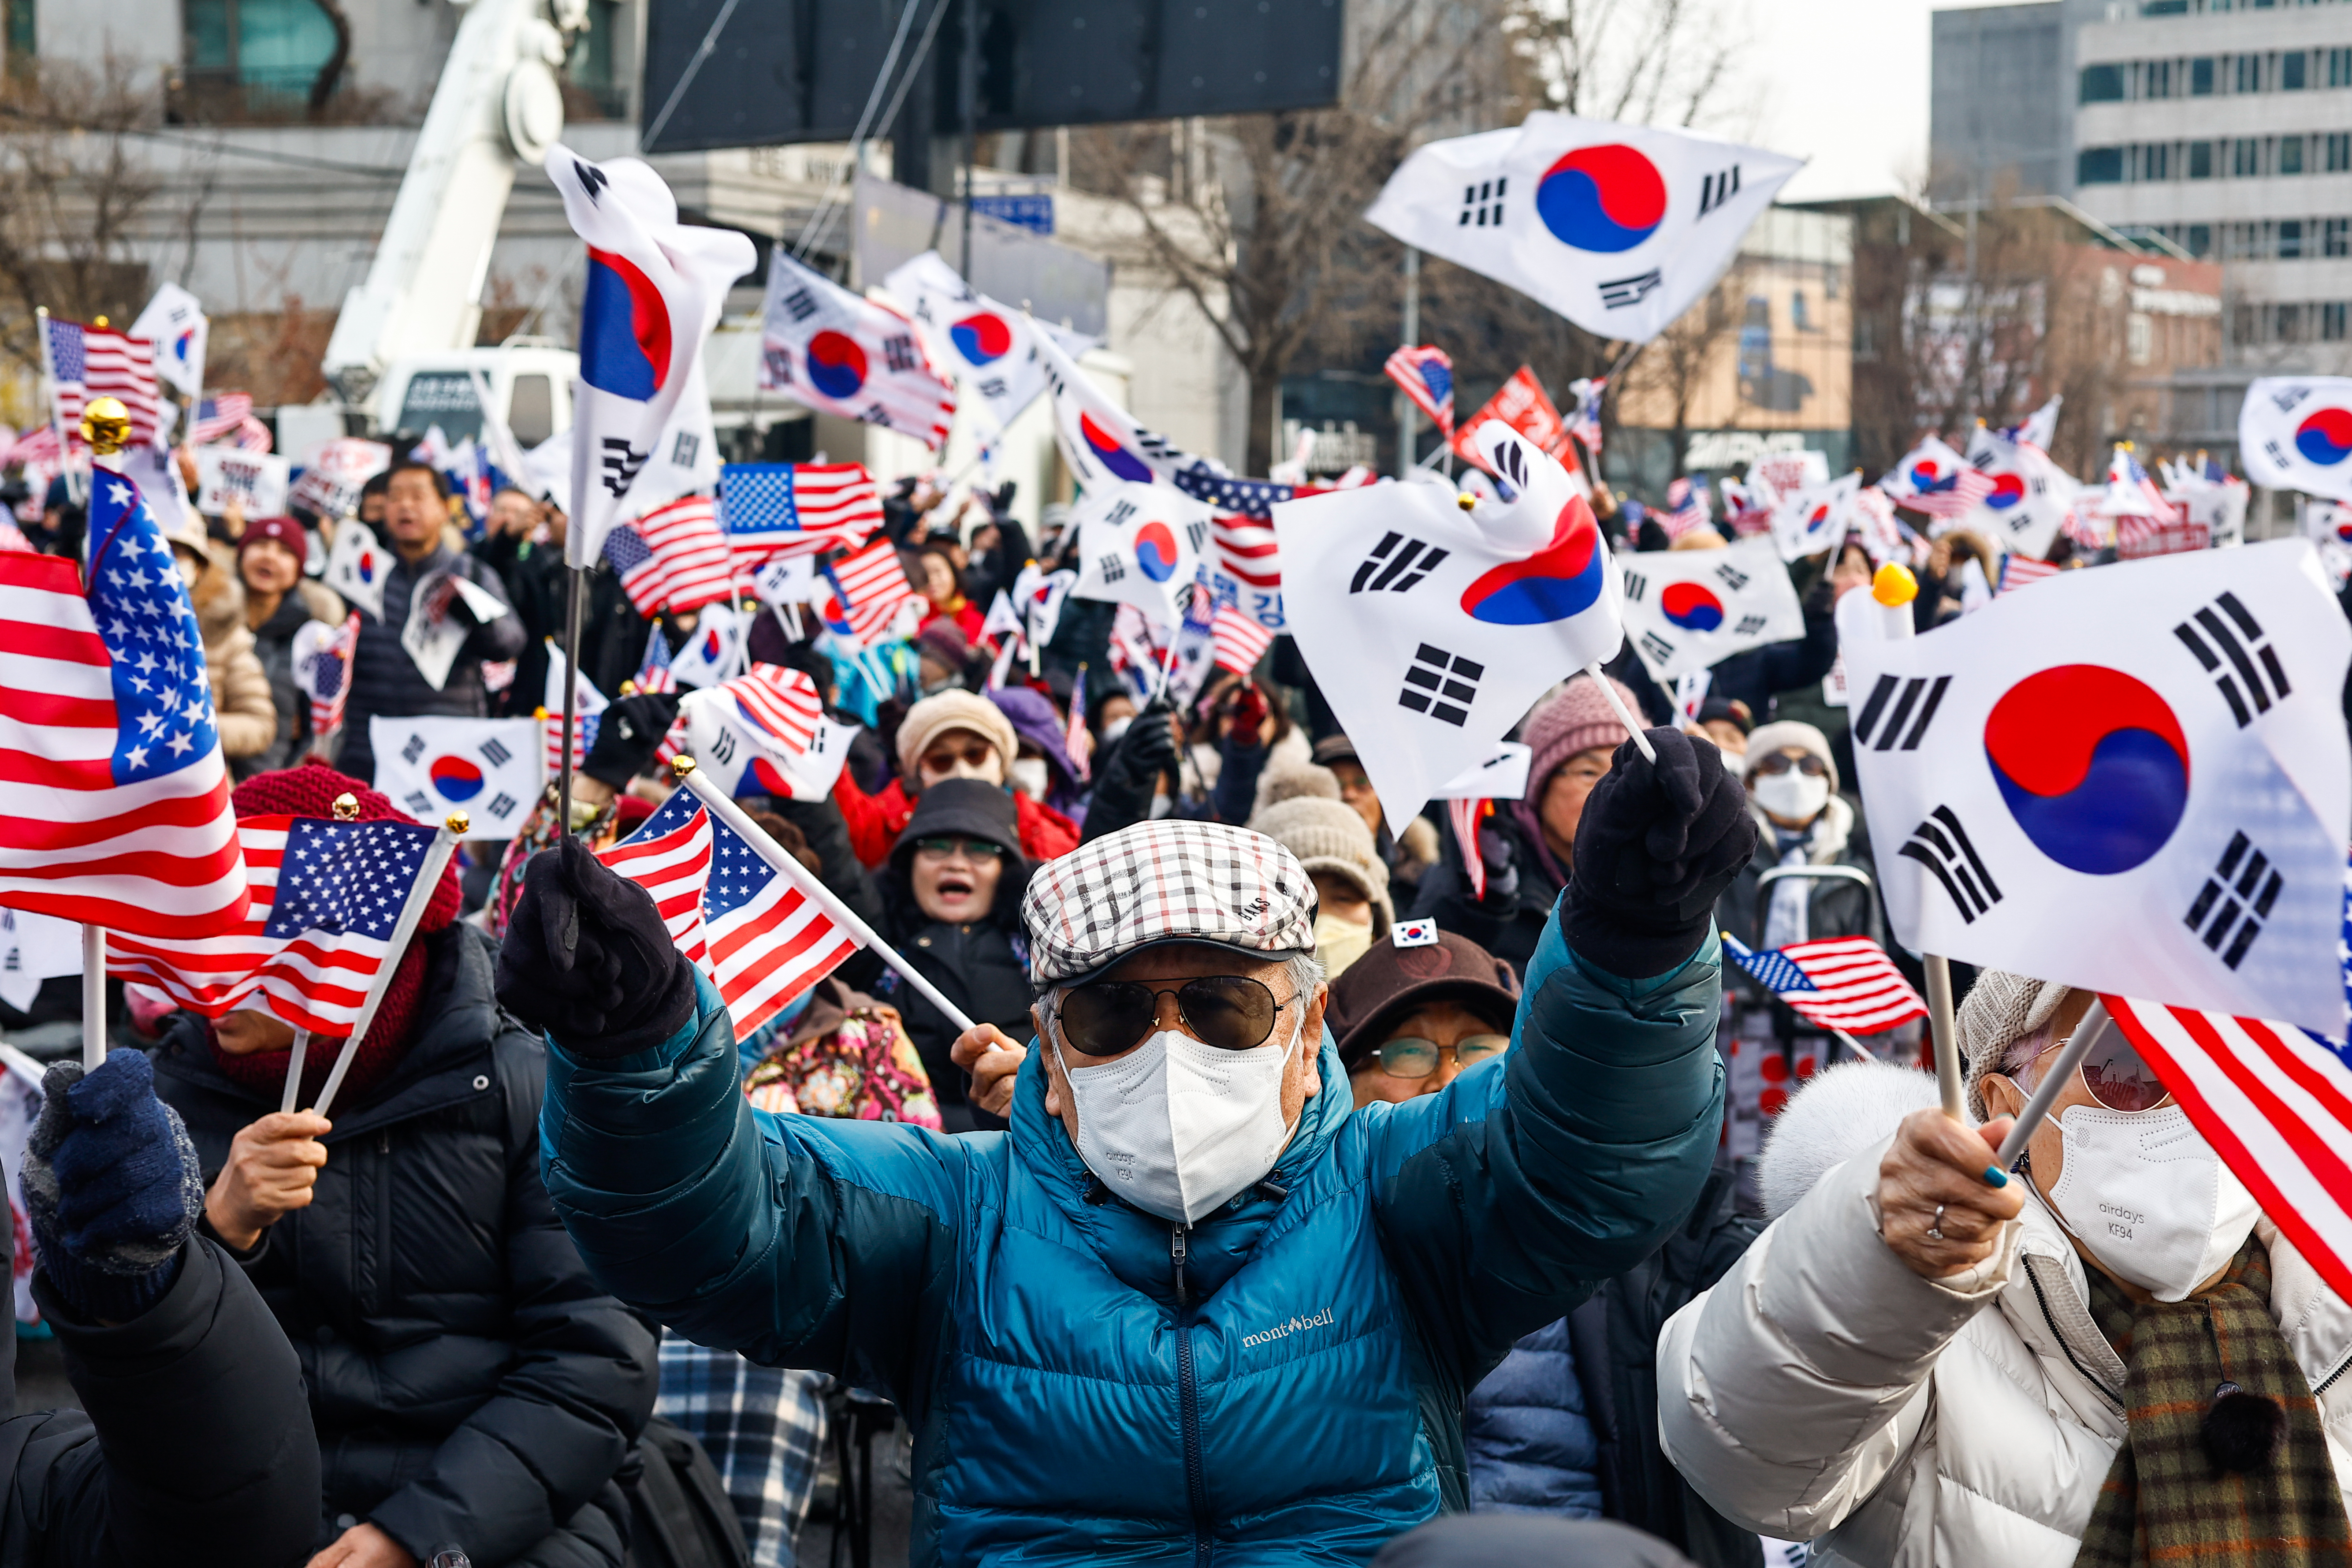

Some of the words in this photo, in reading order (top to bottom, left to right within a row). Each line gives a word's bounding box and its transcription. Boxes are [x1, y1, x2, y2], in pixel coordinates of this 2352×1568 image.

[1238, 898, 1270, 921] BAKS
[1106, 1151, 1135, 1165] airdays
[2099, 1203, 2144, 1224] airdays
[2108, 1222, 2132, 1240] KF94
